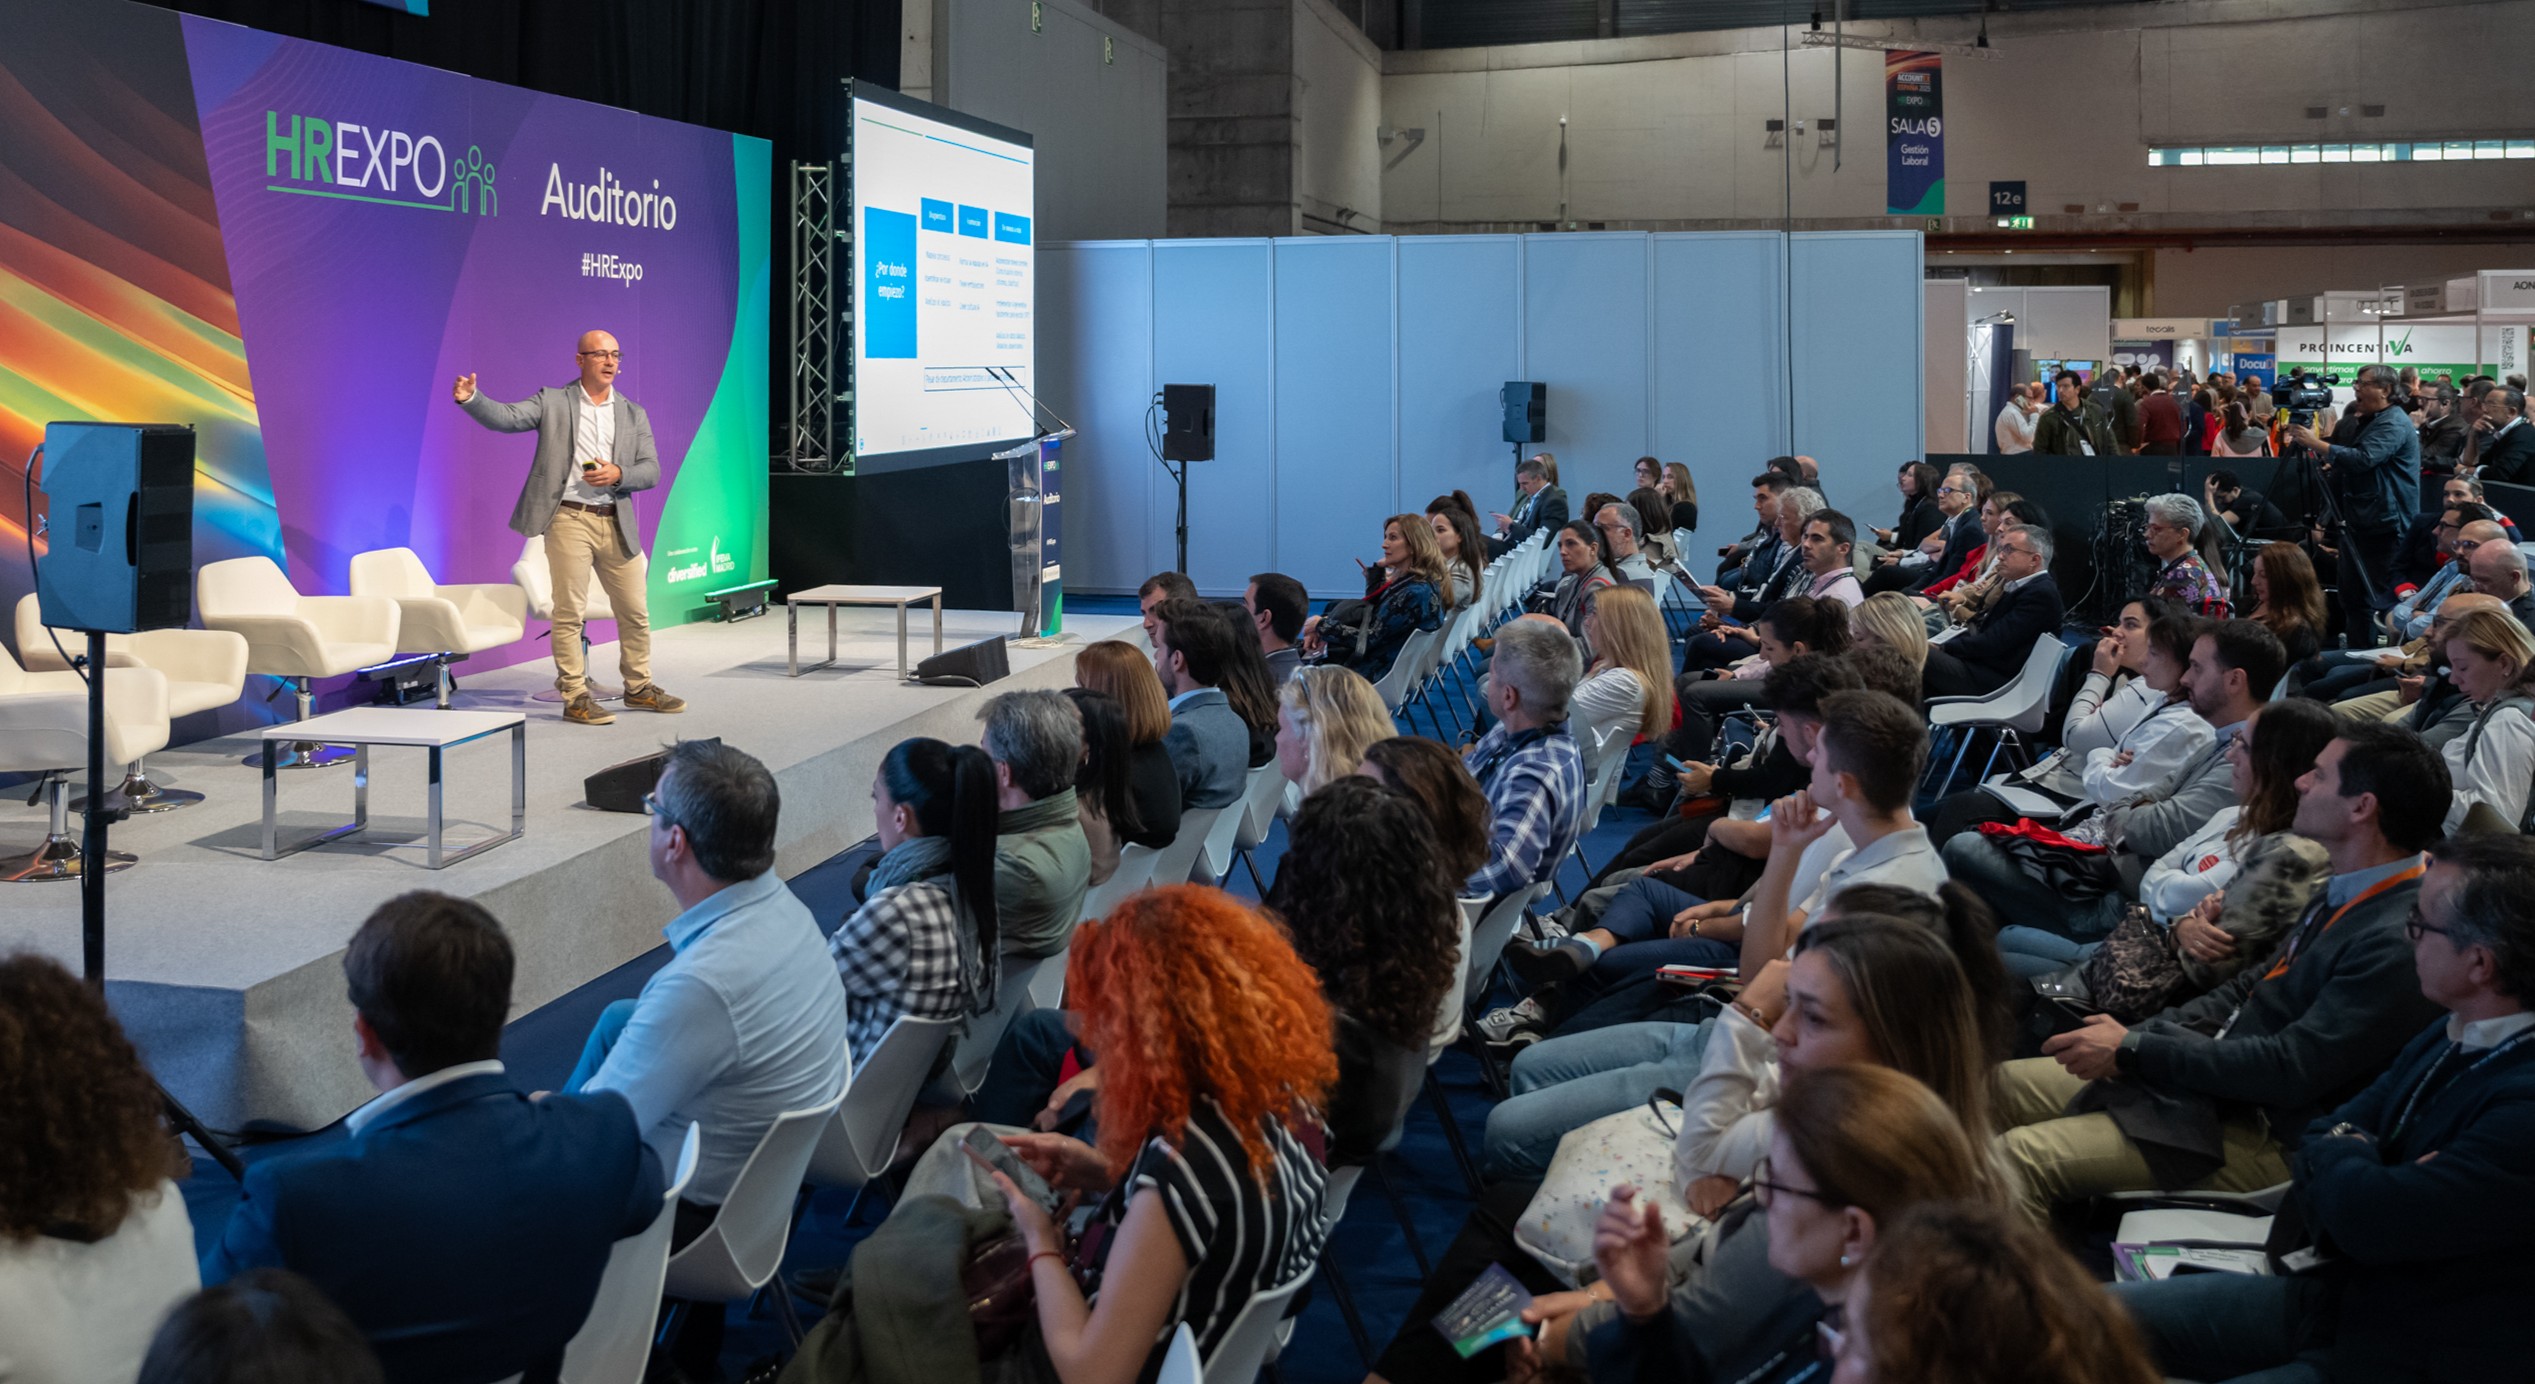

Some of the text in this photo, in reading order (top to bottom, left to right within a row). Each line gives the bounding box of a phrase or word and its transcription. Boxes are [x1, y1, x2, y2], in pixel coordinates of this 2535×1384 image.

[1891, 118, 1926, 134] SALA
[266, 110, 446, 198] HREXPO
[1901, 144, 1929, 154] Gestión
[1902, 156, 1928, 166] Laboral
[541, 162, 677, 231] Auditorio
[1994, 191, 2022, 205] 12e
[581, 252, 643, 288] #HRExpo
[875, 261, 907, 279] ¿Por donde
[877, 283, 905, 301] empiezo?
[2299, 331, 2413, 356] PROINCENIVA
[2303, 366, 2355, 374] onvertimos
[2421, 367, 2452, 375] ahorro
